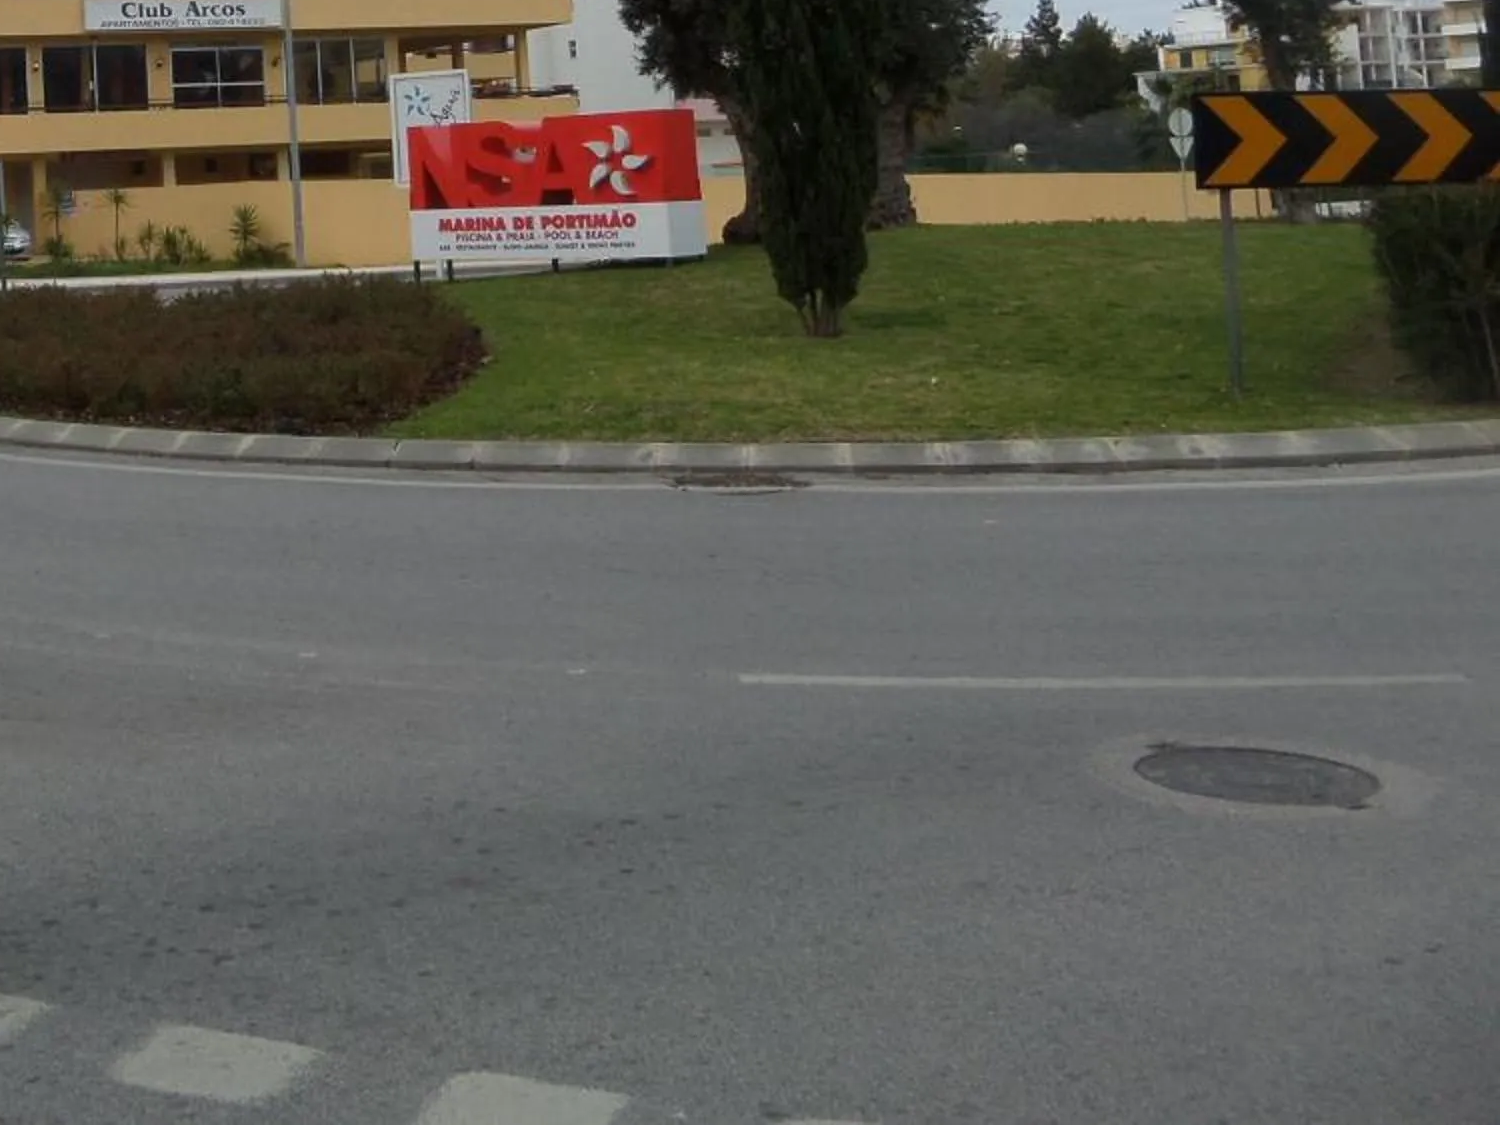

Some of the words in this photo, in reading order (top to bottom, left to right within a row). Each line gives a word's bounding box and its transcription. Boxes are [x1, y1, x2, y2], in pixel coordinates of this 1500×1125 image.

[121, 1, 173, 19] Club
[184, 0, 247, 18] Arcos
[438, 216, 506, 232] MARINA
[513, 216, 535, 231] DE
[541, 209, 637, 230] PORTIMÃO
[456, 233, 493, 242] PISCINA
[506, 231, 535, 241] PRAIA
[544, 230, 572, 240] POOL
[585, 229, 619, 240] BEACH
